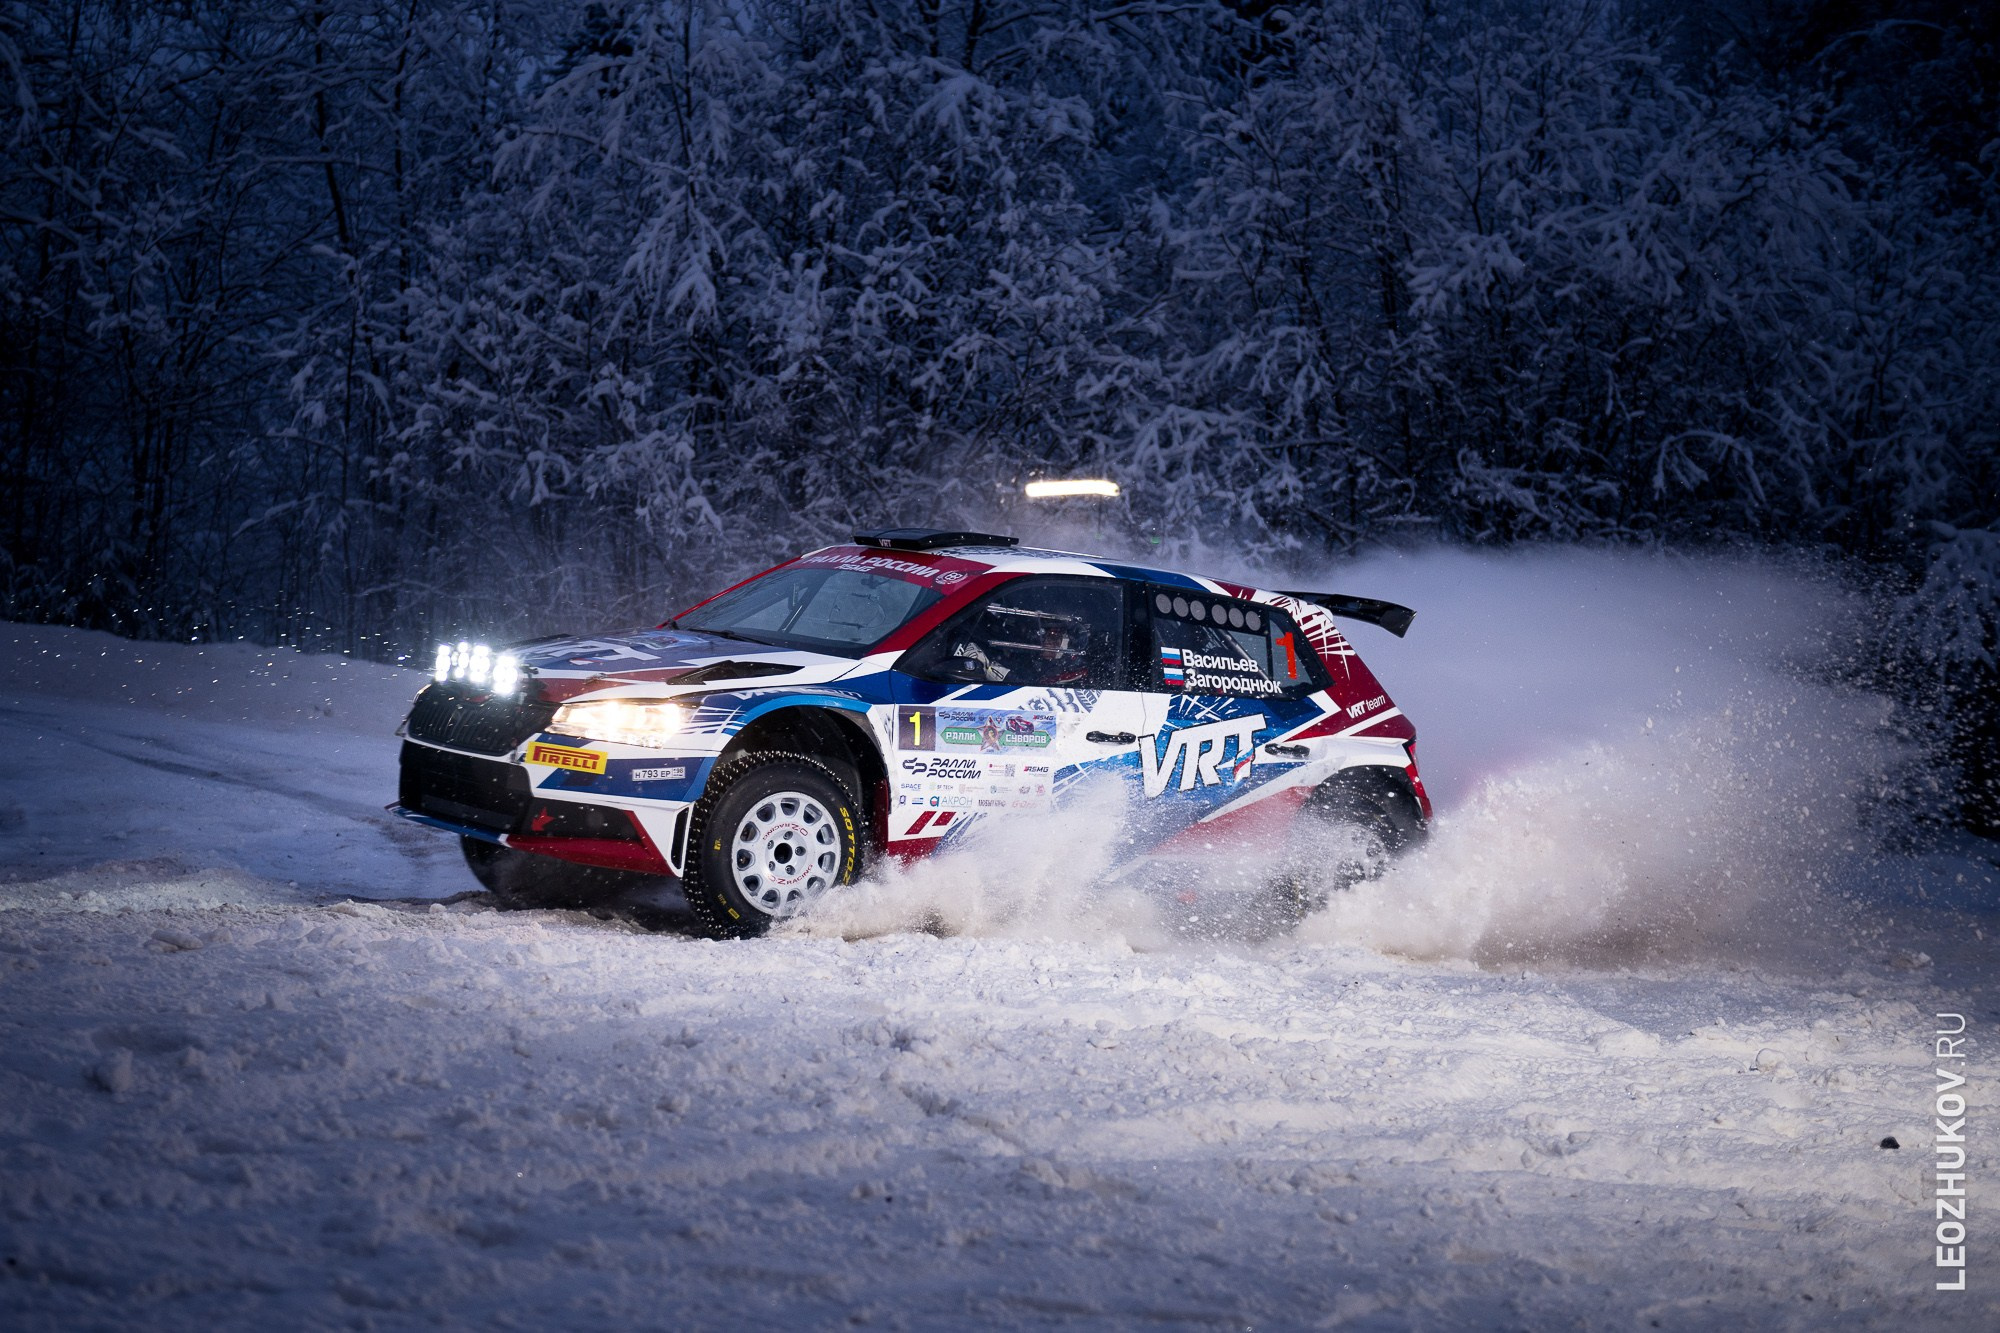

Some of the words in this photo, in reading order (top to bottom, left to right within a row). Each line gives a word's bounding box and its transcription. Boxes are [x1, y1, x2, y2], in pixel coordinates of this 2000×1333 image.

[878, 539, 892, 548] VRT
[863, 556, 940, 578] РОССИИ
[1181, 648, 1259, 673] Васильев
[1275, 632, 1297, 680] 1
[1185, 668, 1282, 694] Загороднюк
[1346, 701, 1365, 719] VRT
[1366, 695, 1386, 711] team
[909, 711, 921, 746] 1
[946, 731, 976, 741] РАЛЛИ
[1005, 734, 1047, 744] СУВОРОВ
[532, 745, 601, 770] PIRELLI
[930, 758, 977, 769] РАЛЛИ
[1138, 713, 1267, 800] VRT
[641, 769, 659, 778] 793
[926, 768, 982, 779] РОССИИ
[942, 796, 973, 806] АКРОН
[786, 864, 813, 885] RACING
